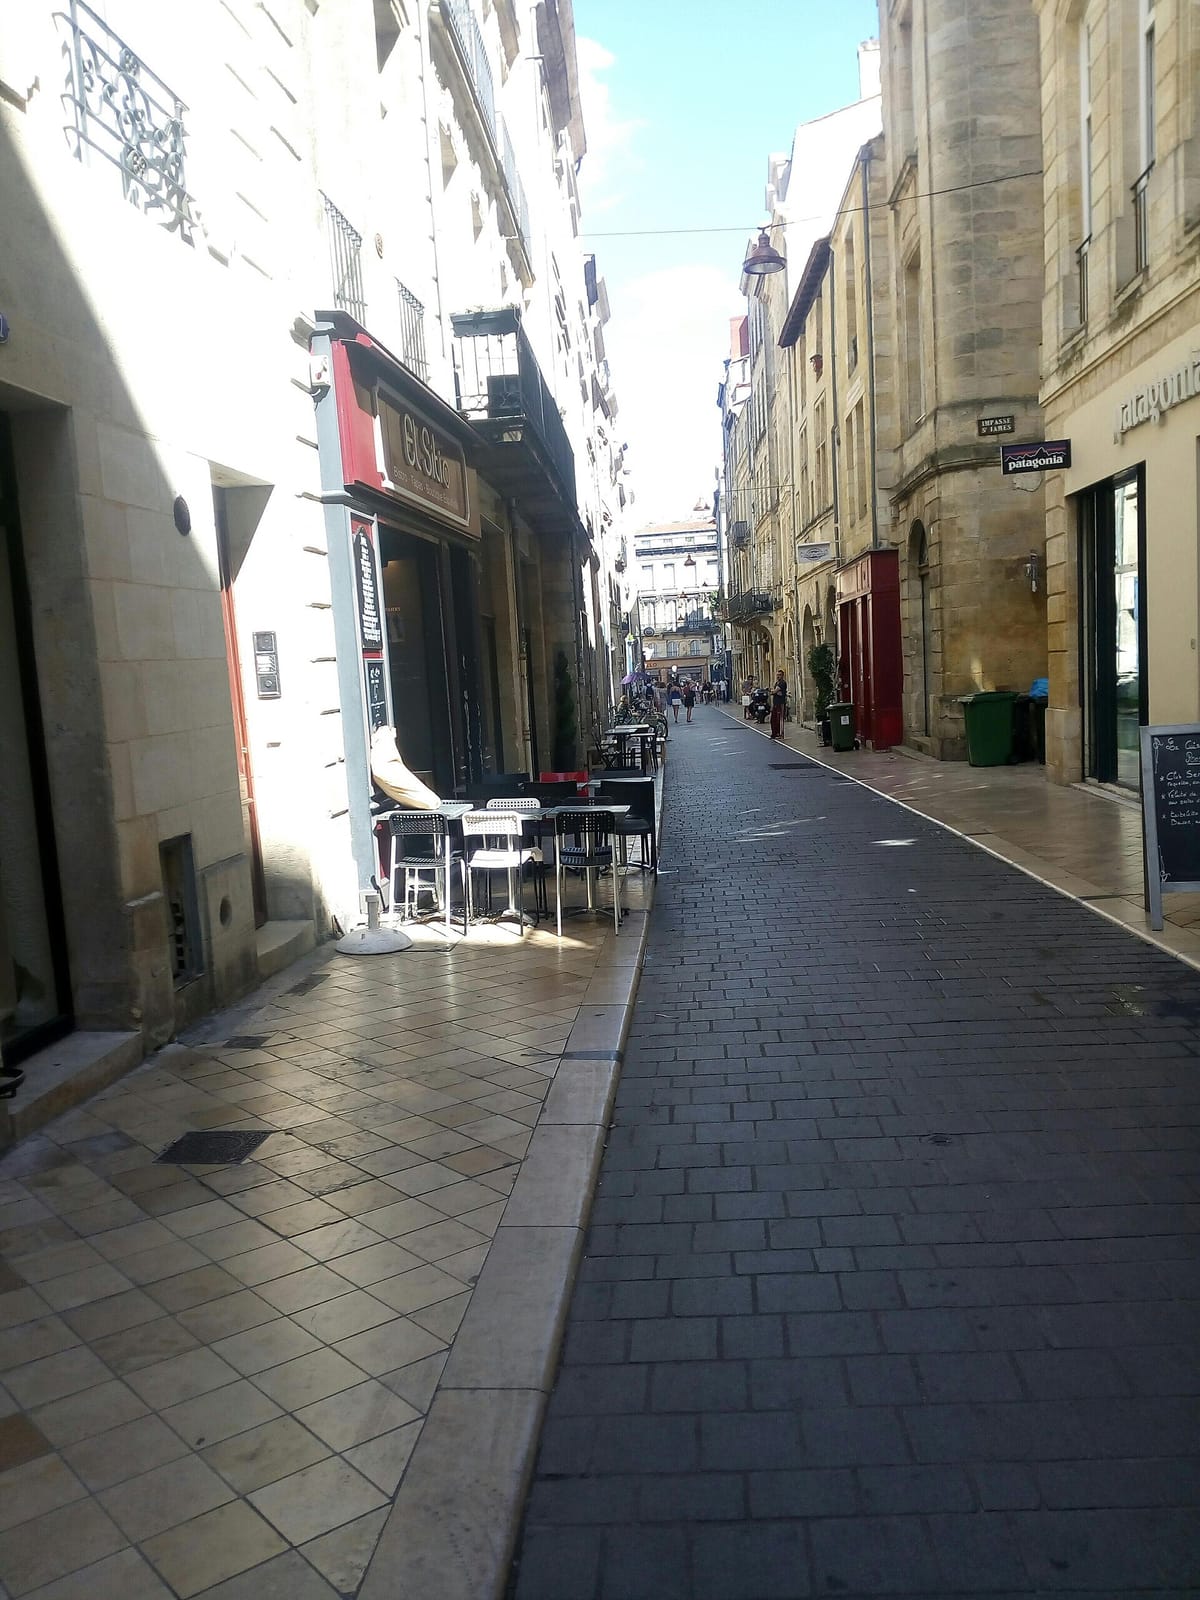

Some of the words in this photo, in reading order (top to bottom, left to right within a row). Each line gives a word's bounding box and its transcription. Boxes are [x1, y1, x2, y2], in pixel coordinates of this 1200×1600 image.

[981, 418, 1012, 427] IMPASSE
[422, 427, 450, 489] Sitio
[1008, 455, 1064, 471] patagonia
